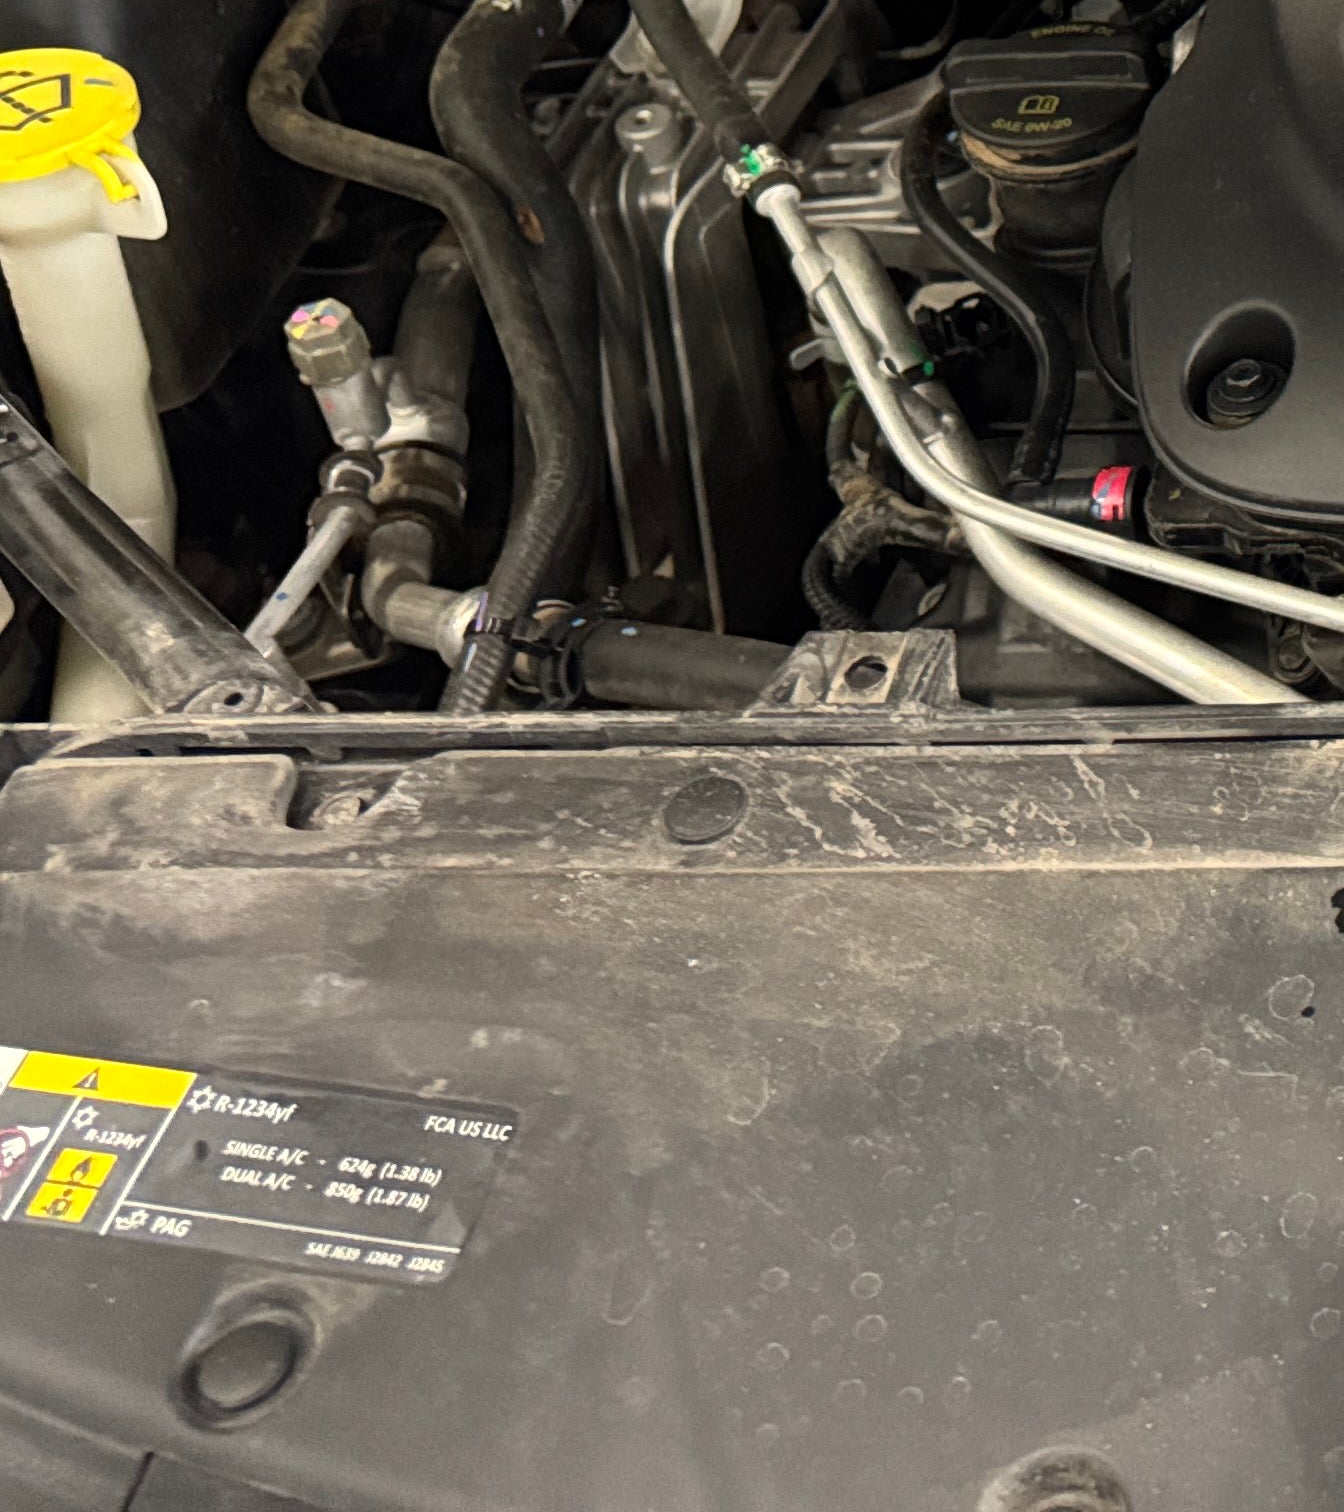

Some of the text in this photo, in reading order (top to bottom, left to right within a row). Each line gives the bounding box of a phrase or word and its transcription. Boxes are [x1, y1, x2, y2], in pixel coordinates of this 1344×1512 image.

[991, 117, 1073, 133] SAE 0W-20
[213, 1094, 298, 1124] R-1234yf
[424, 1115, 513, 1141] FCA US LLC
[222, 1140, 278, 1161] SINGLE
[276, 1148, 310, 1166] A/C
[338, 1157, 377, 1179] 624g
[379, 1162, 420, 1182] (1.38
[420, 1168, 443, 1188] lb)
[219, 1166, 262, 1186] DUAL
[261, 1172, 297, 1191] A/C
[323, 1182, 364, 1204] 850g
[365, 1187, 408, 1206] (1.87
[406, 1193, 431, 1213] lb)
[150, 1216, 192, 1238] PAG
[304, 1242, 332, 1257] SAE
